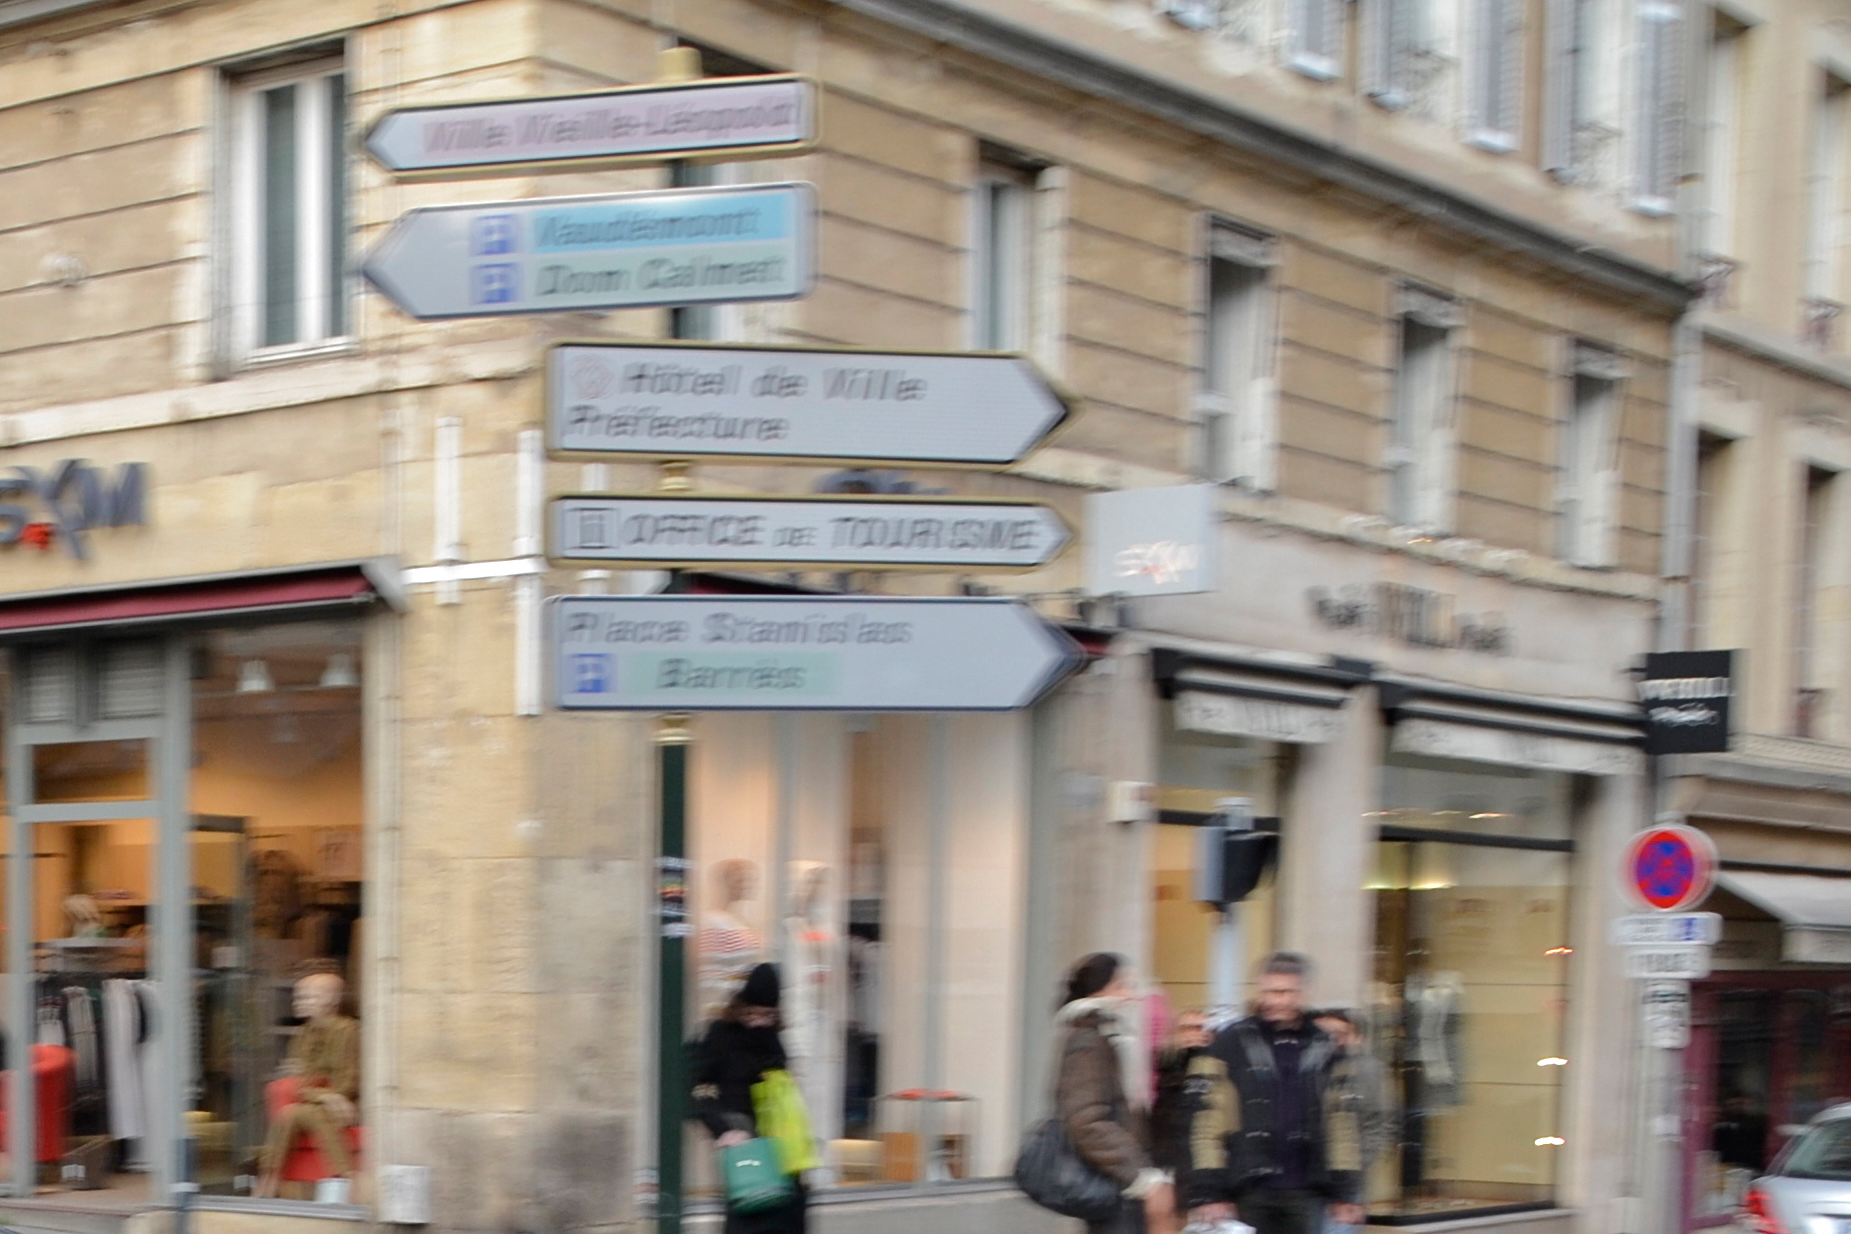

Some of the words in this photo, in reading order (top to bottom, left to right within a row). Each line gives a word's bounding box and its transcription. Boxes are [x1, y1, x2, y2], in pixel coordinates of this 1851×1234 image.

[425, 120, 511, 153] Ville
[534, 263, 630, 297] Dom
[620, 363, 742, 398] Hôtel
[752, 366, 808, 398] de
[822, 366, 928, 401] Ville
[565, 404, 789, 441] Préfecture
[620, 514, 766, 548] OFFICE
[773, 525, 817, 548] DE
[830, 515, 1042, 550] TOURISME
[561, 611, 690, 643] Place
[701, 611, 914, 644] Stanislas
[656, 657, 807, 690] Barrès
